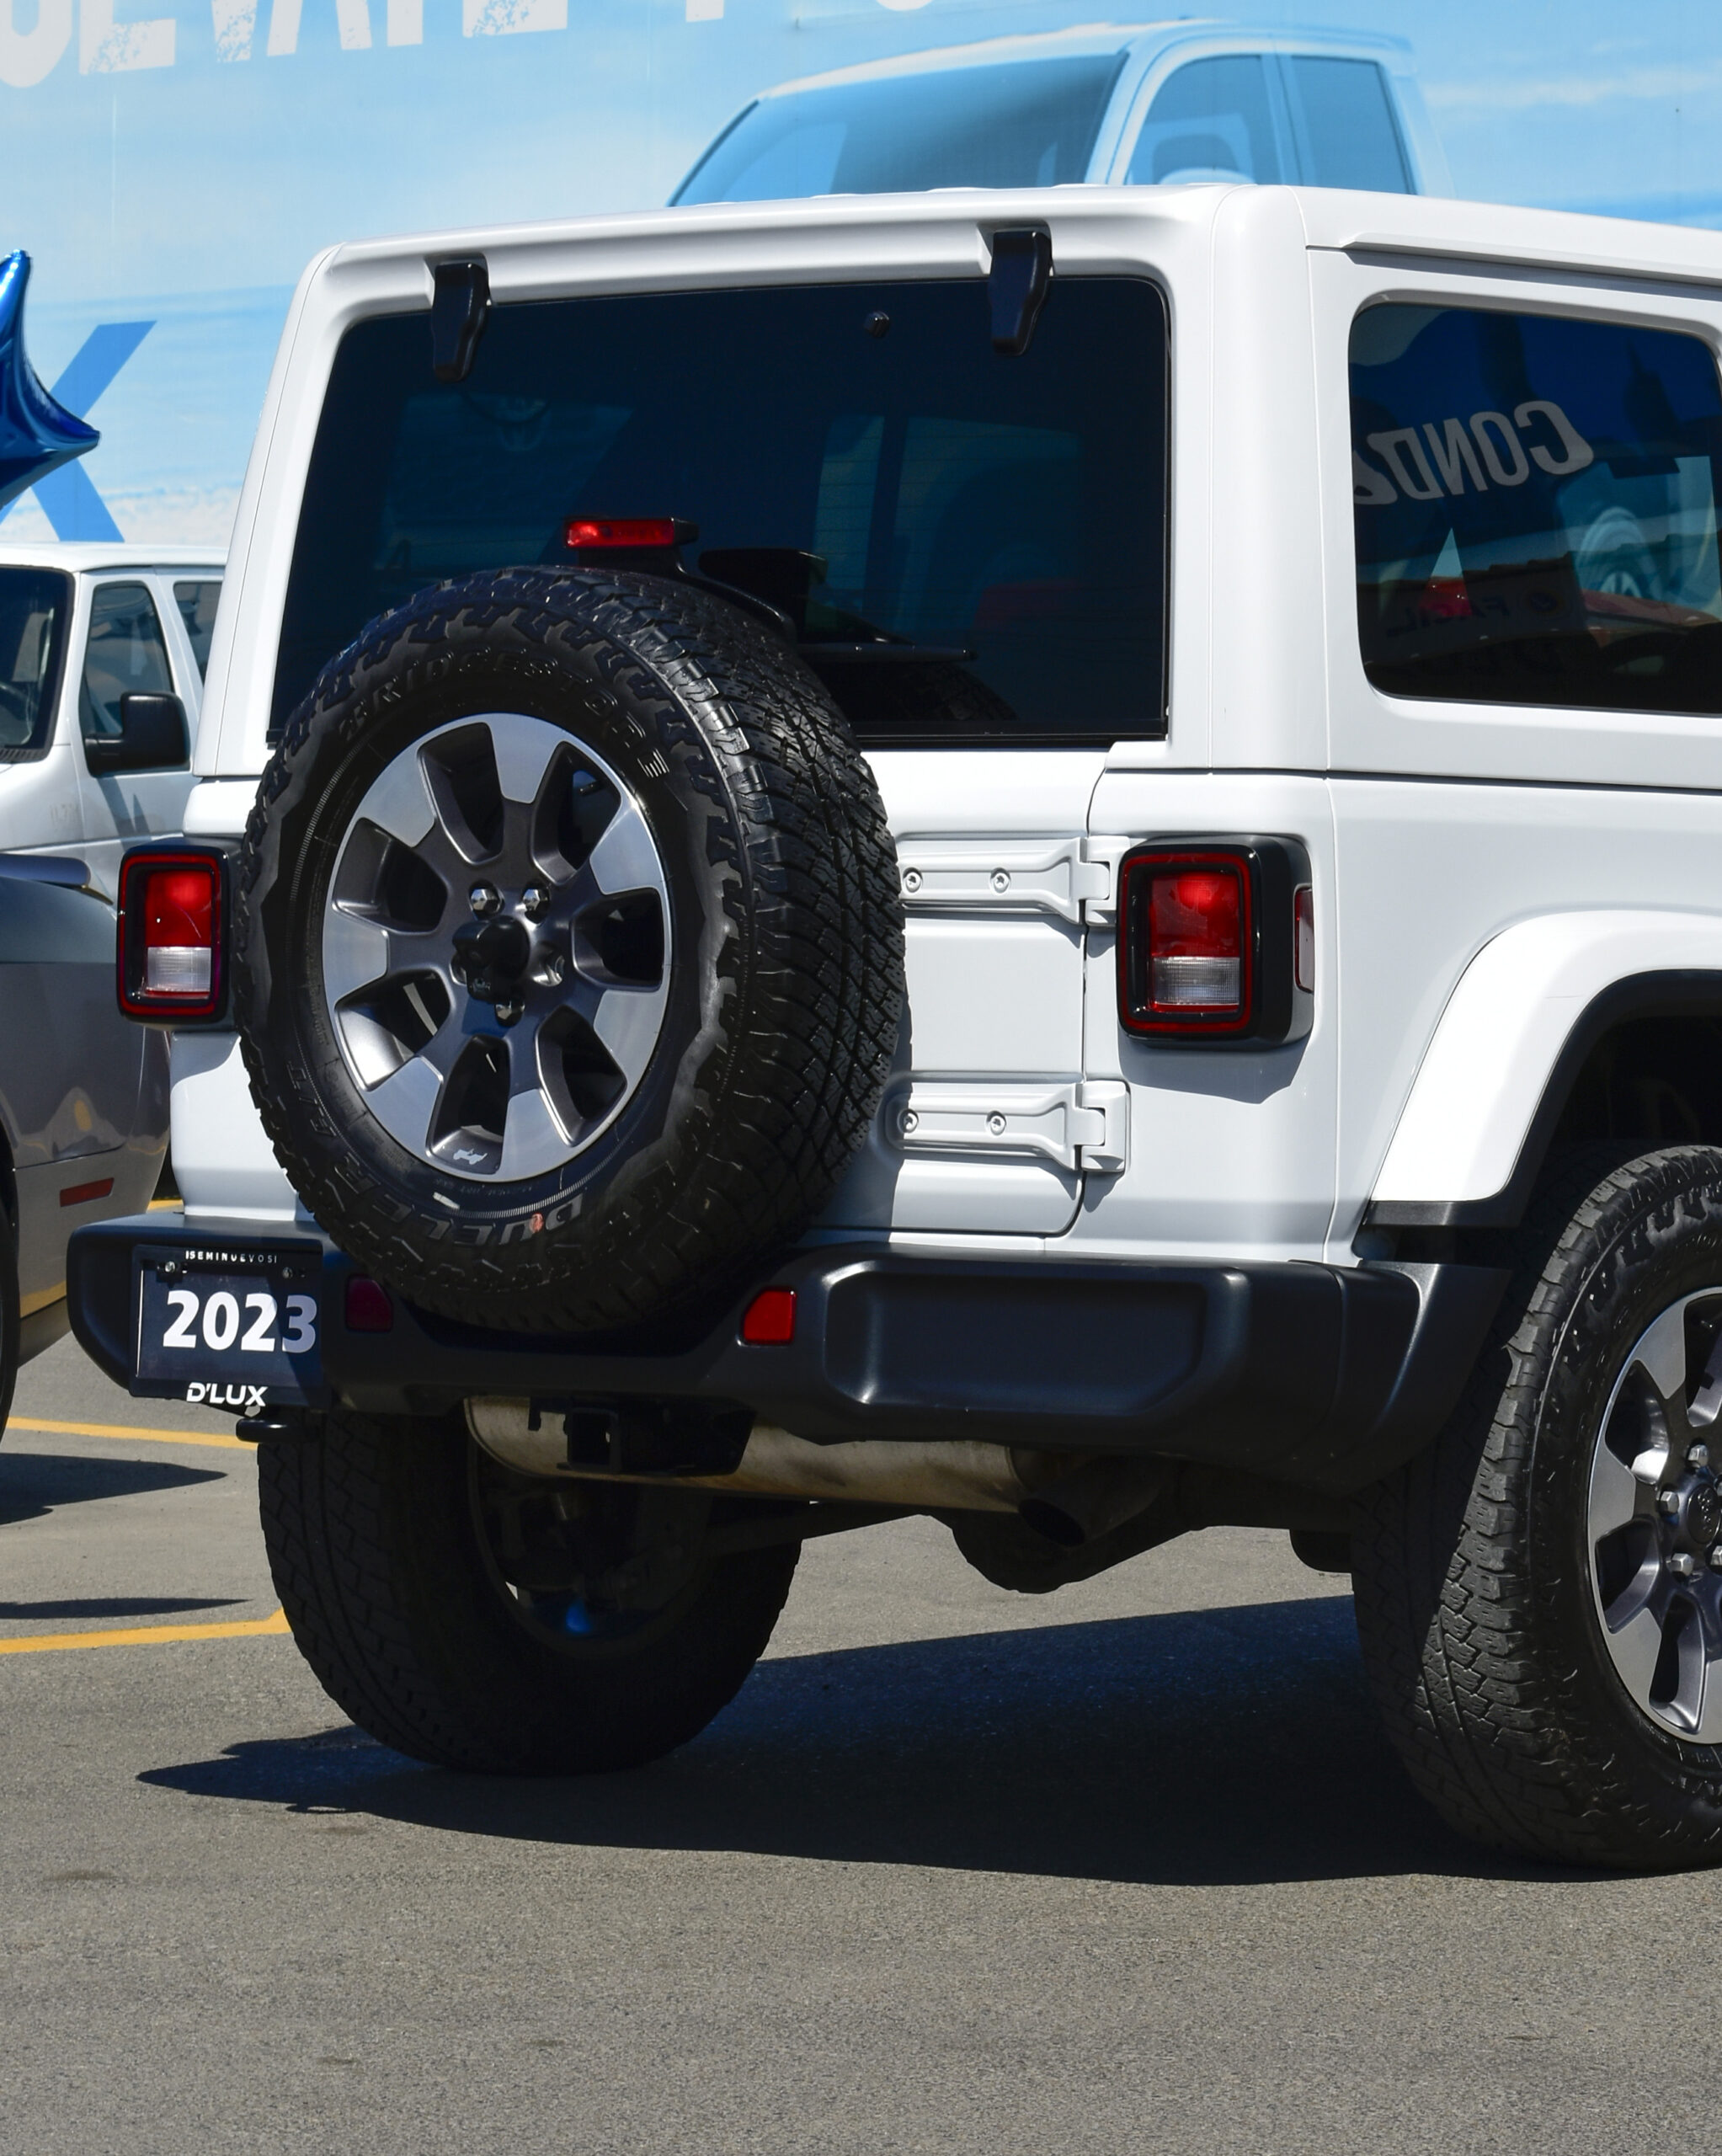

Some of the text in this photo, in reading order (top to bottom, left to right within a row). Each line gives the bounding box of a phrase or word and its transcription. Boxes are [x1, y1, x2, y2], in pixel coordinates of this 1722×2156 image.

[339, 646, 670, 779] BRIDGESTONE
[334, 1151, 584, 1246] DUELER
[163, 1289, 317, 1354] 2023
[186, 1381, 268, 1407] D'LUX
